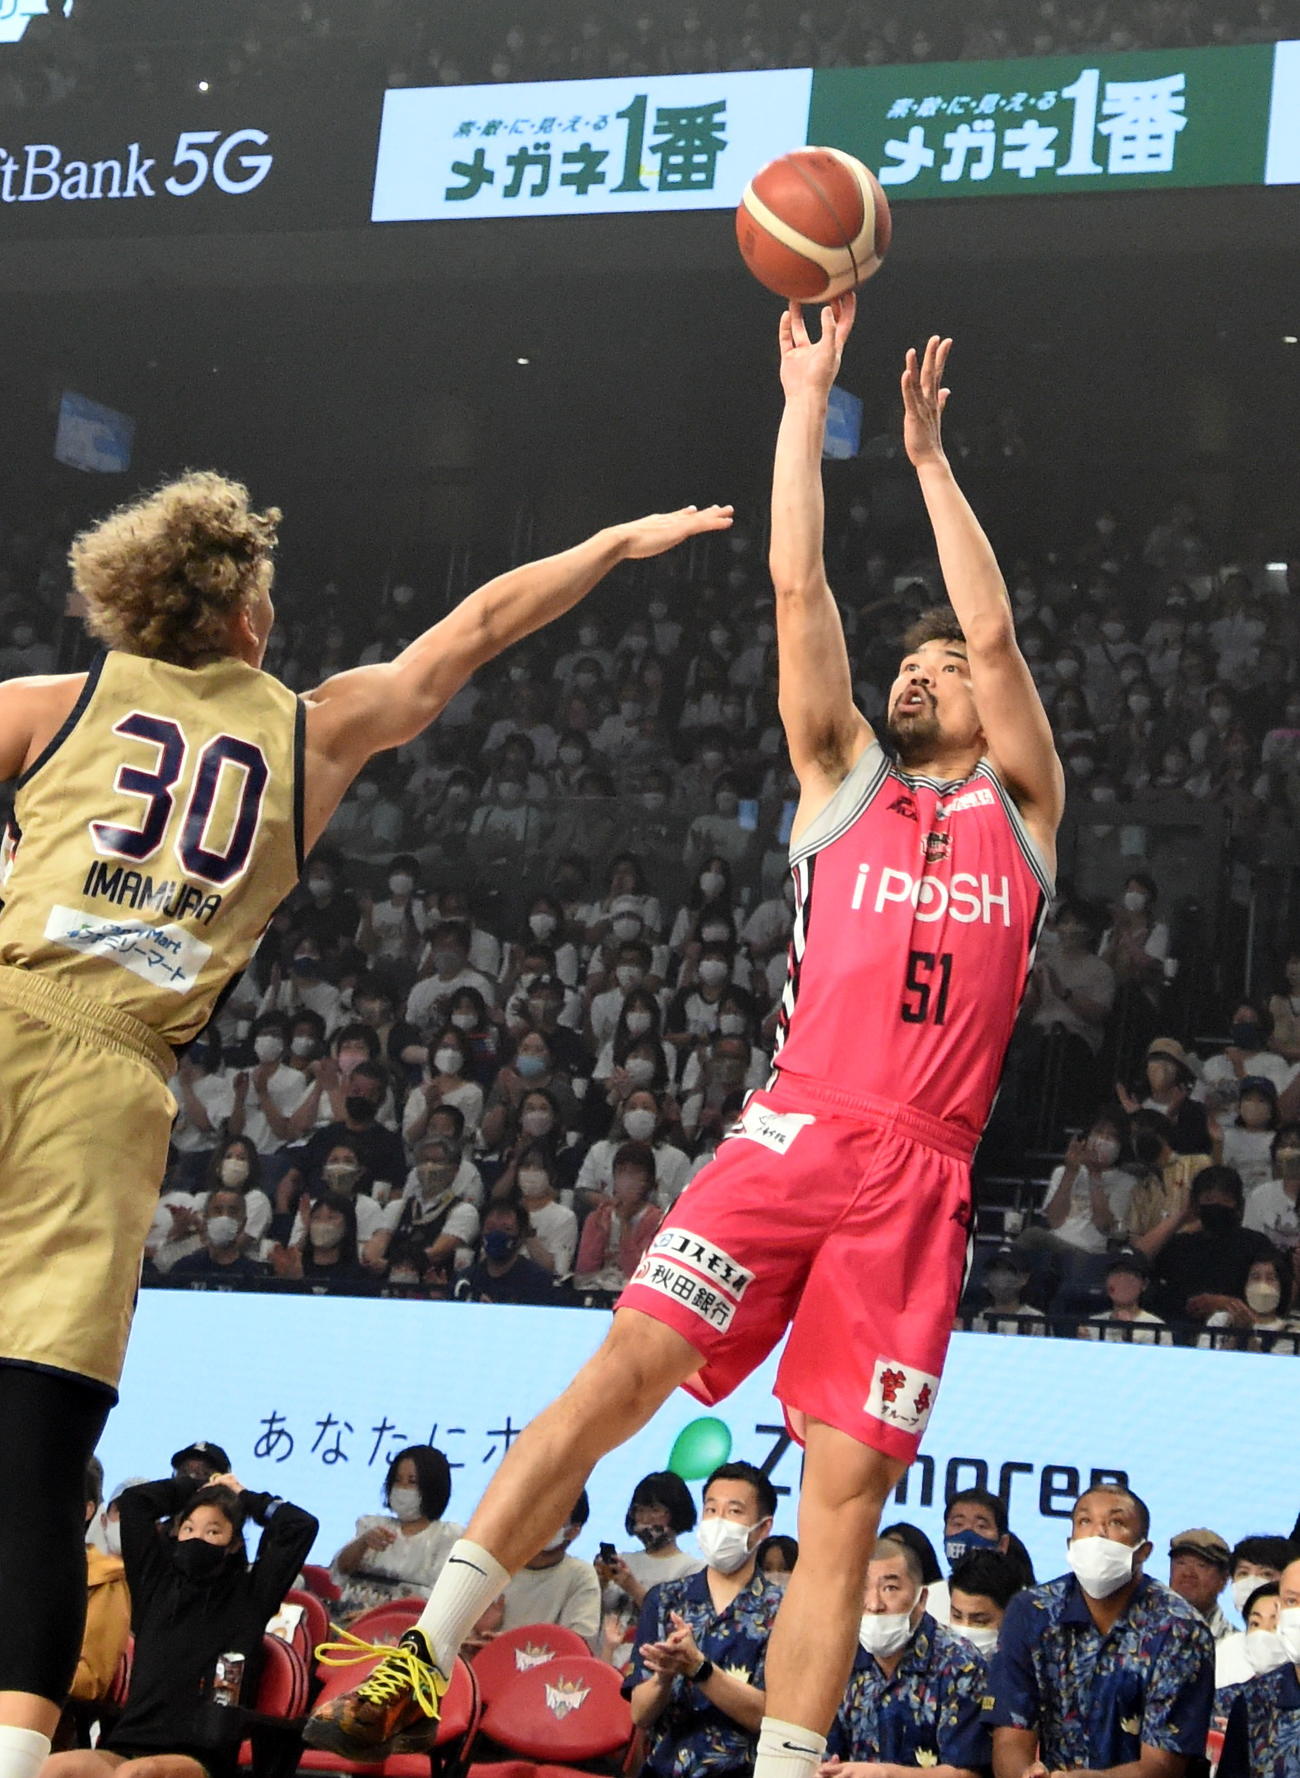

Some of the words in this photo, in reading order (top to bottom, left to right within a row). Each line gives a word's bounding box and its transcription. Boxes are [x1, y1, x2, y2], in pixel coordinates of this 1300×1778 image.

[0, 142, 156, 203] tBank
[165, 128, 273, 197] 5G
[89, 709, 269, 888] 30
[874, 867, 1011, 927] POSH
[901, 950, 954, 1026] 51
[651, 1264, 730, 1326] 秋田銀行
